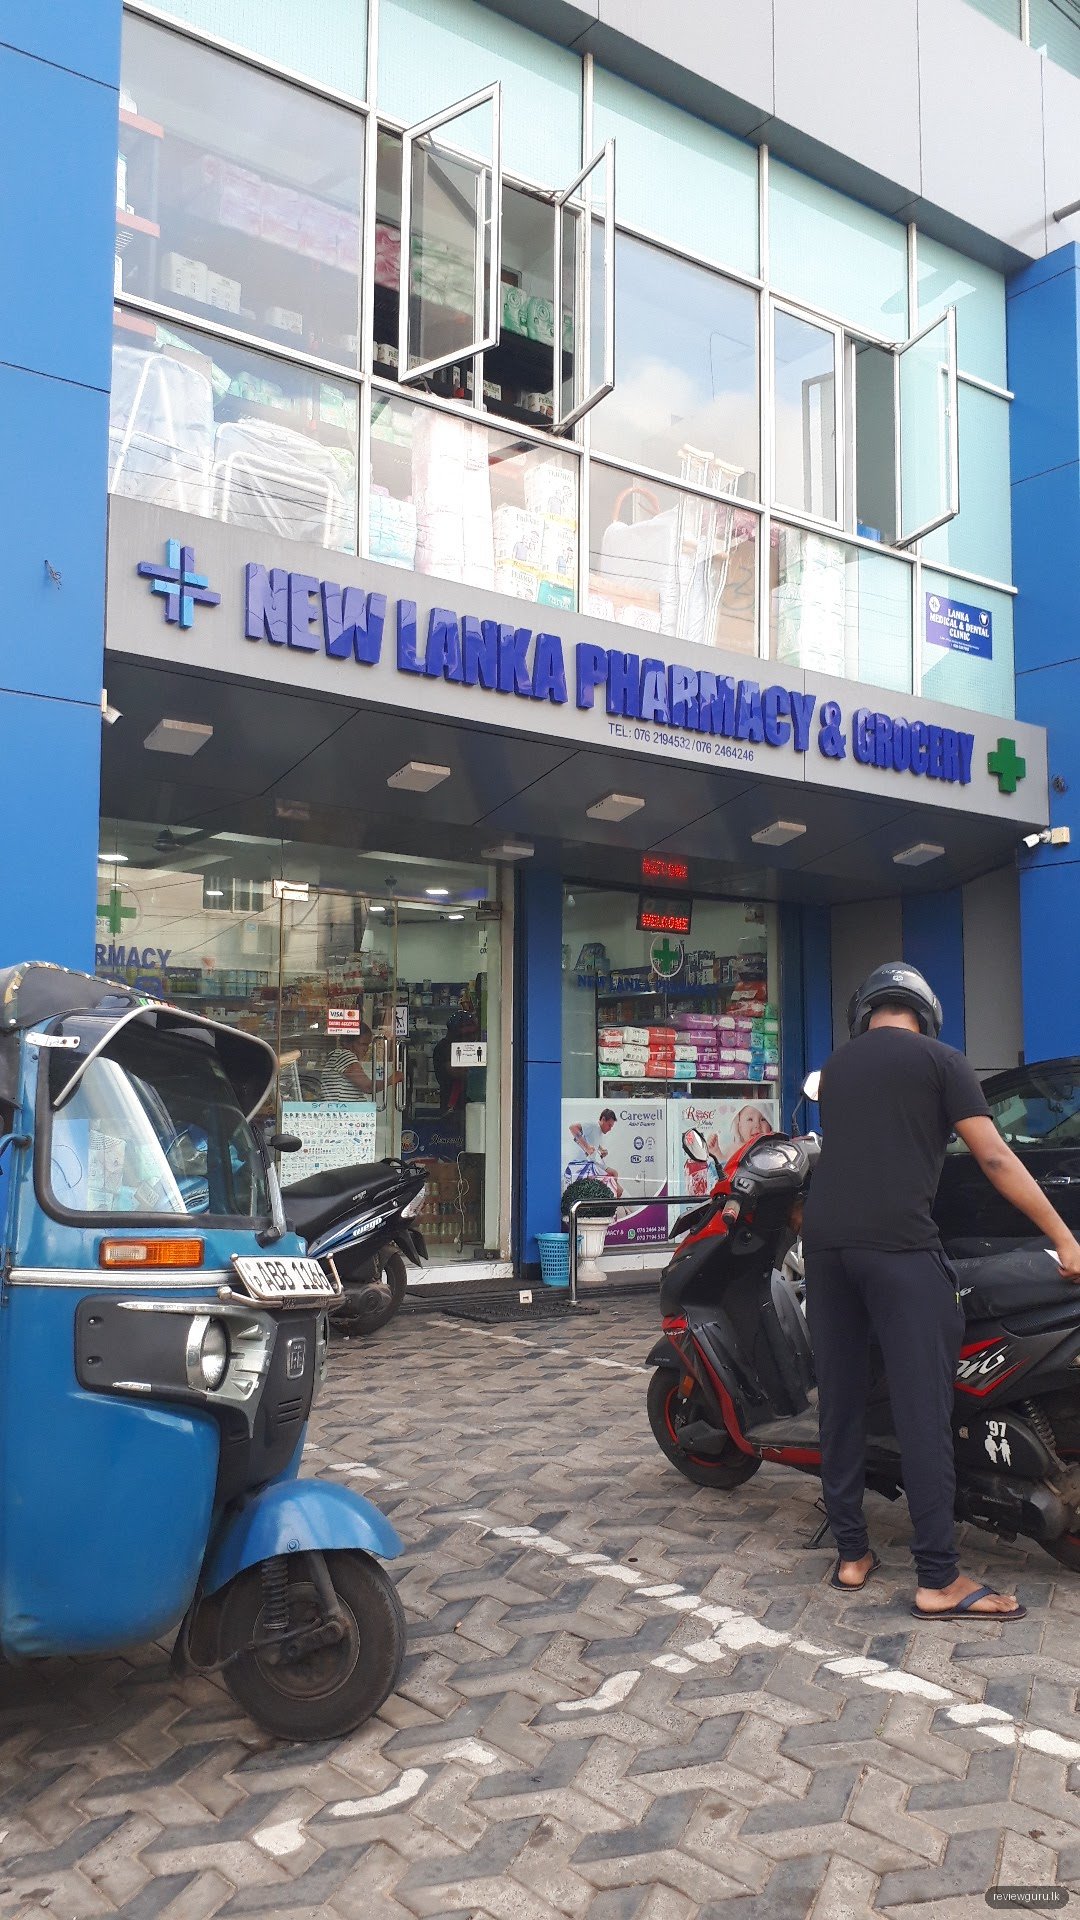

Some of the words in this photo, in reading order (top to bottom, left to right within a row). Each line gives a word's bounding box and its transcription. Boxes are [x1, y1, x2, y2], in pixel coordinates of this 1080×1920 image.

[929, 612, 958, 629] MEDICAL
[958, 622, 965, 631] &
[965, 623, 990, 638] DENTAL
[947, 608, 970, 623] LANKA
[949, 628, 971, 642] CLINIC
[244, 561, 388, 666] NEW
[397, 599, 568, 704] LANKA
[575, 642, 816, 752] PHARMACY
[819, 701, 846, 760] &
[852, 707, 975, 785] GROCERY
[608, 722, 632, 738] TEL:
[634, 728, 651, 743] 076
[714, 743, 754, 762] 2464246
[330, 1010, 343, 1018] VISA
[619, 1108, 664, 1121] Carewell
[256, 1261, 296, 1291] ABB
[291, 1261, 331, 1291] 1166
